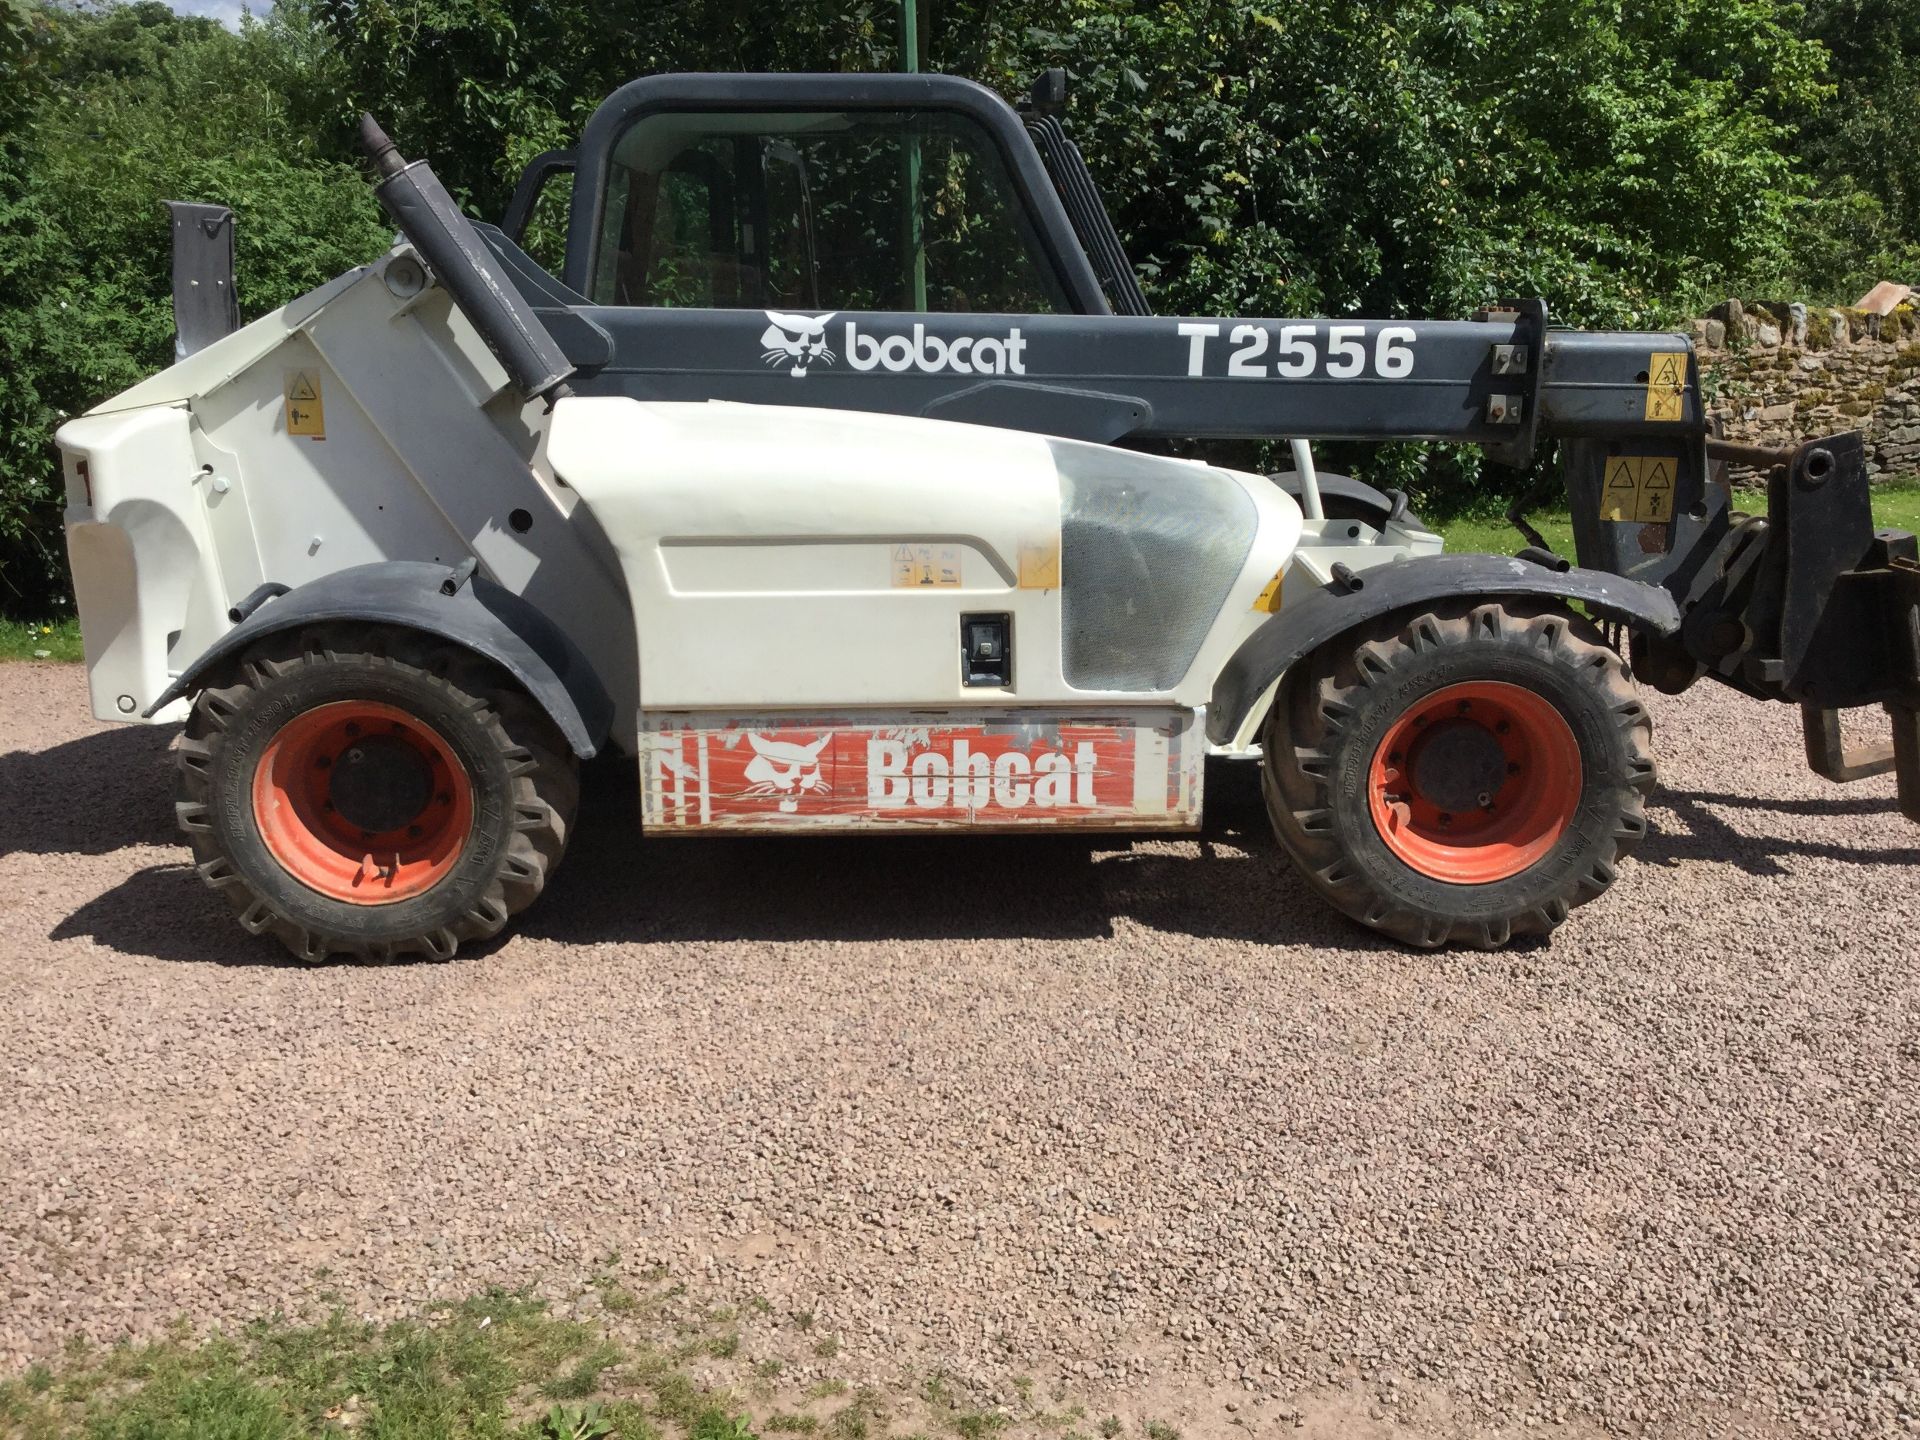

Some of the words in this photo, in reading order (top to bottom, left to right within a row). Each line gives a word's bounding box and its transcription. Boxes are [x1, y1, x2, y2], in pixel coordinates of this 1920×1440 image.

[845, 321, 1027, 375] bobcat
[1177, 322, 1417, 379] T2556
[867, 738, 1098, 808] Bobcat
